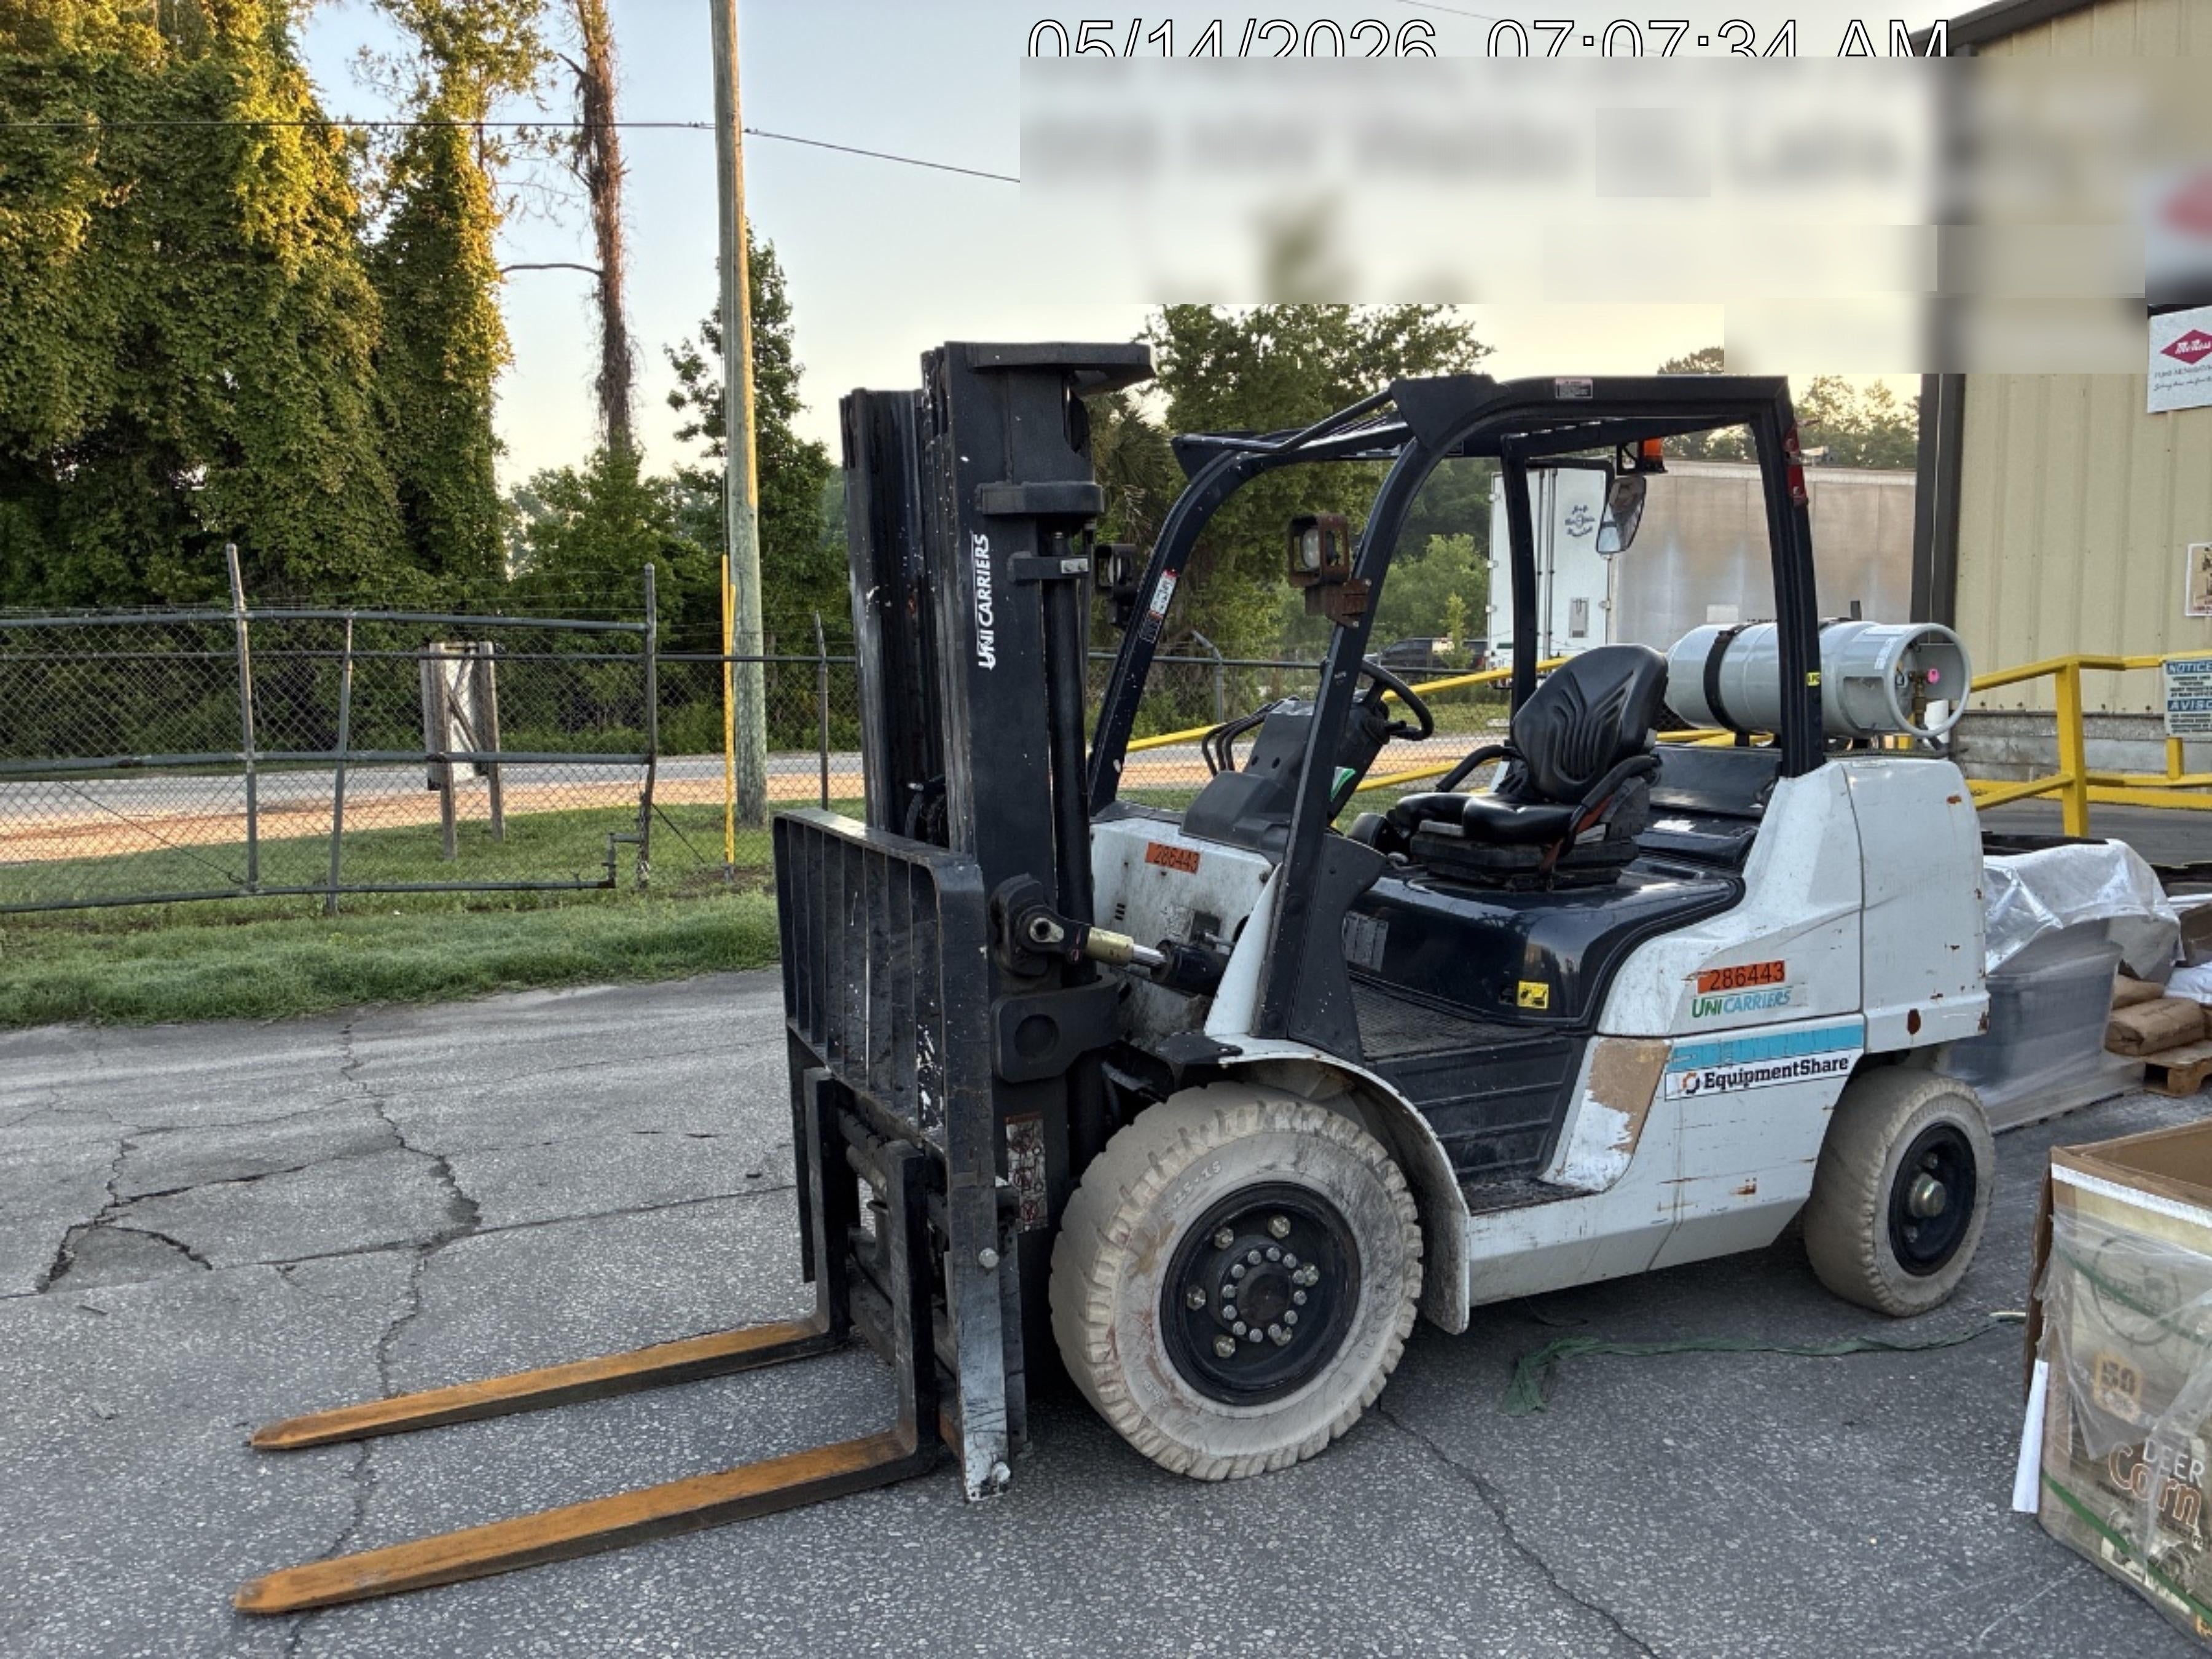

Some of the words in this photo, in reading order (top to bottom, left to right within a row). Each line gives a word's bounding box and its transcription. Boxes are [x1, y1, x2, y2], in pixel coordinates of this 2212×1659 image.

[973, 533, 996, 671] UNICARRIERS
[1710, 961, 1784, 990] 286443
[1692, 990, 1790, 1018] UNICARRIERS
[1704, 1057, 1848, 1089] EquipmentShare
[2143, 1437, 2205, 1488] DEER
[2108, 1441, 2202, 1529] Corn
